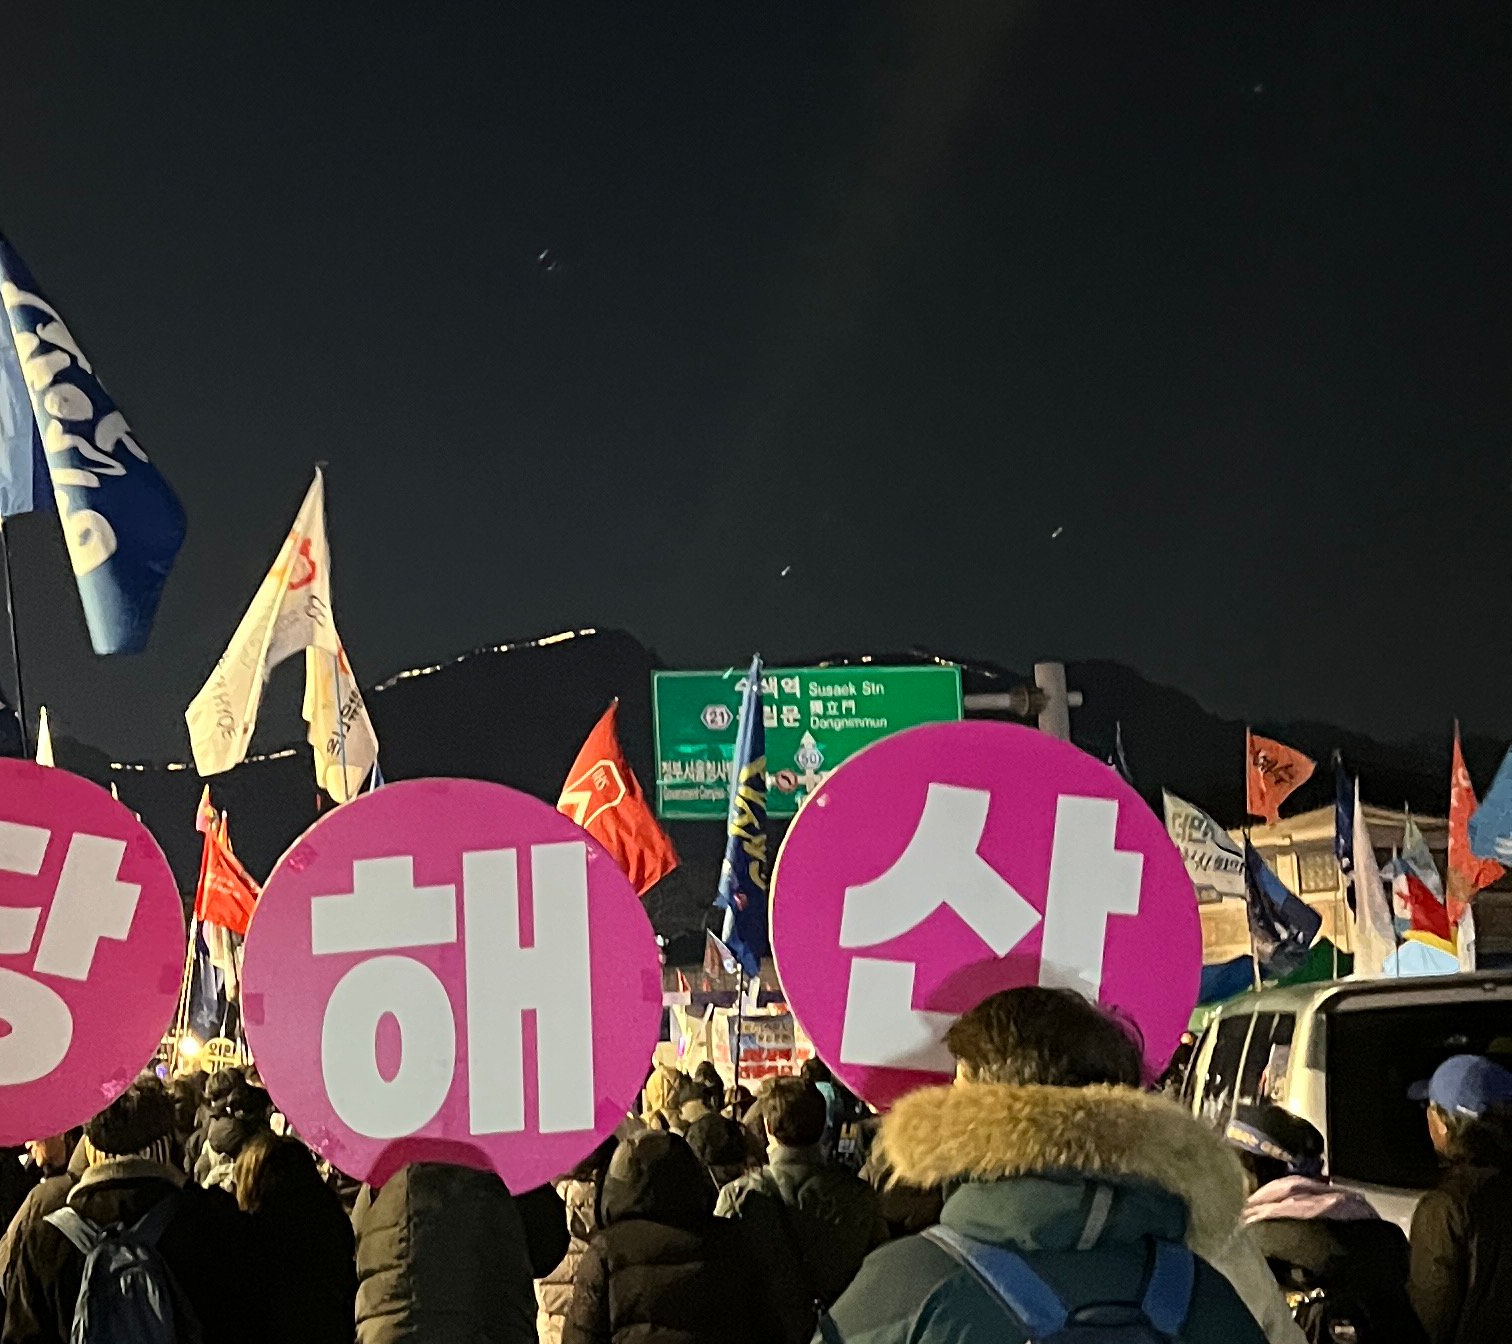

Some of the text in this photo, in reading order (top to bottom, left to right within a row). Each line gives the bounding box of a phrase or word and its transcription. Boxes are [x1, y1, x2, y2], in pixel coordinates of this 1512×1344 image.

[808, 680, 885, 698] Susaek Stn
[708, 710, 727, 726] 21
[737, 703, 801, 729] 립문
[311, 841, 595, 1140] 해
[840, 784, 1144, 1071] 산
